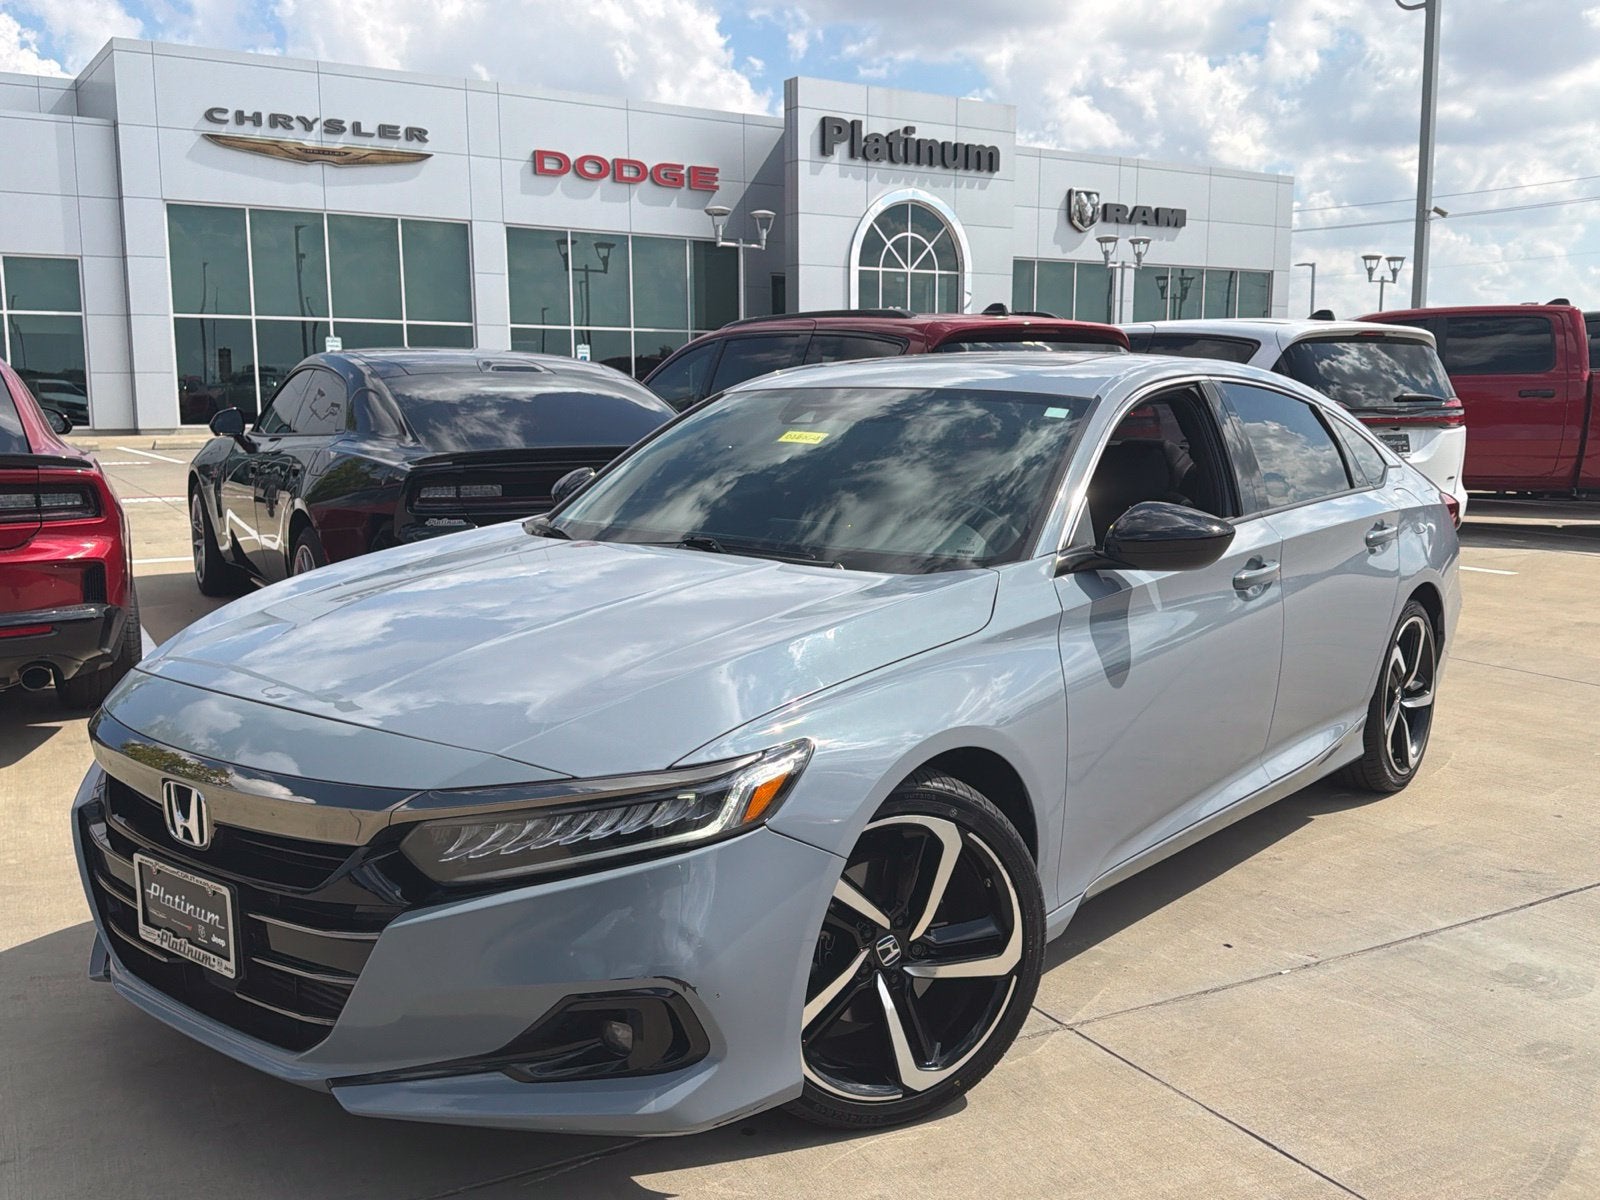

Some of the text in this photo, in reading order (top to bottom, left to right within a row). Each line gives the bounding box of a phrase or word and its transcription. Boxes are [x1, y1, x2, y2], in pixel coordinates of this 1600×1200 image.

[204, 107, 429, 143] CHRYSLER
[821, 115, 1000, 173] Platinum
[532, 149, 721, 191] DODGE
[1102, 203, 1187, 228] RAM
[146, 882, 225, 930] Platinum
[159, 929, 215, 968] Platinum
